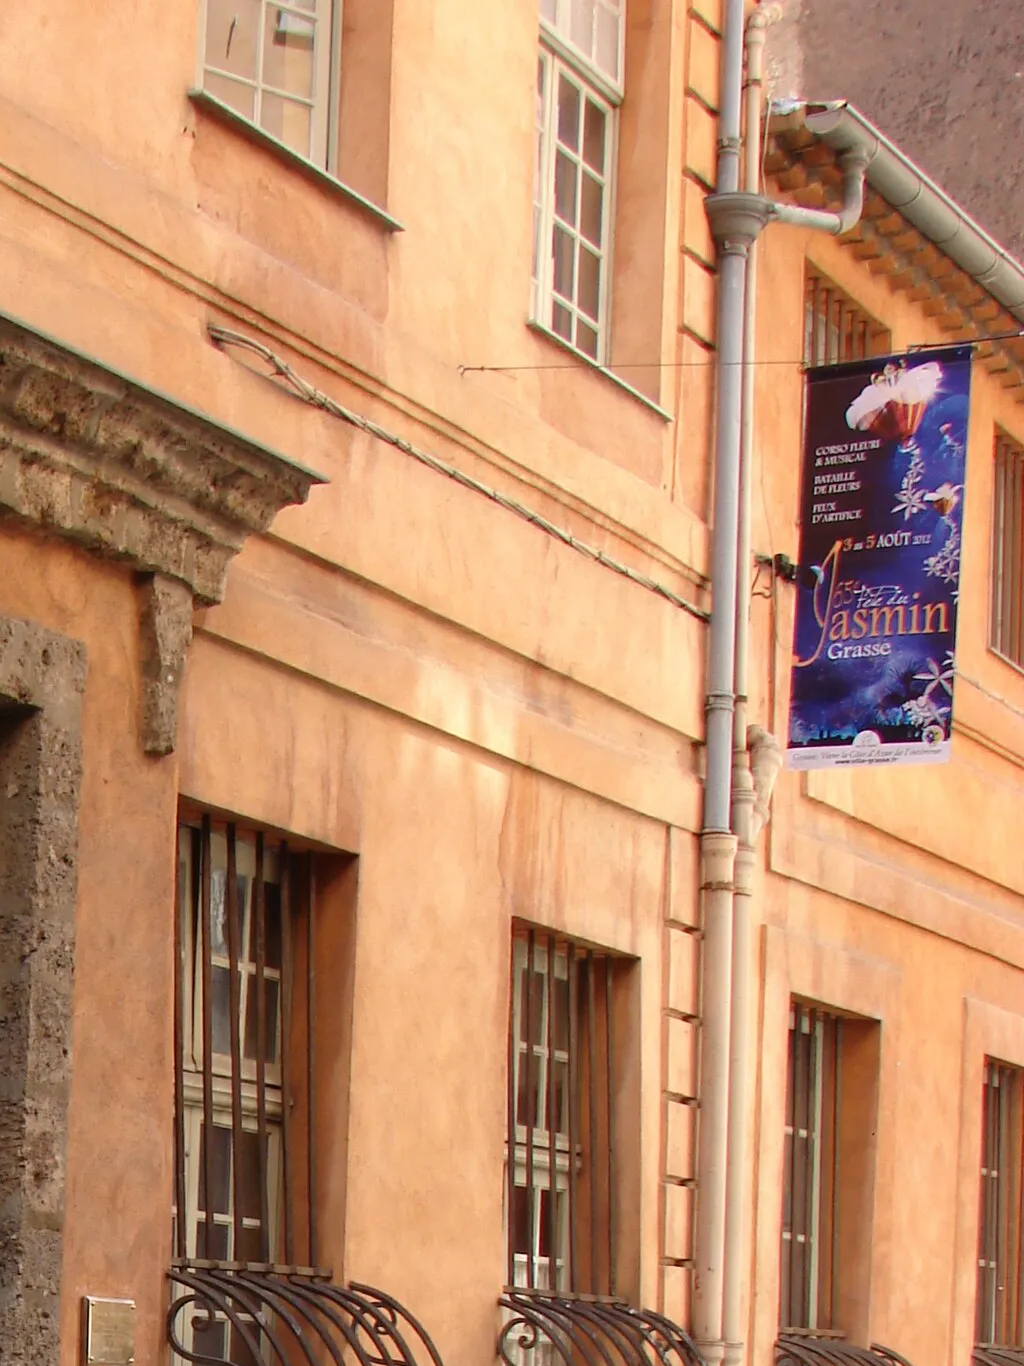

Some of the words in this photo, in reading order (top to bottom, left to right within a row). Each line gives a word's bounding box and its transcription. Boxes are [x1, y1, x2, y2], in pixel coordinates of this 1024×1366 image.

[815, 444, 849, 456] CORSO
[850, 439, 881, 452] FLEURI
[824, 452, 867, 466] MUSICAL
[814, 471, 856, 484] BATAILLE
[813, 485, 827, 495] DE
[828, 481, 861, 493] FLEURS
[812, 502, 836, 513] FEUX
[812, 509, 862, 524] D'ARTIFICE
[842, 538, 853, 552] 3
[865, 534, 876, 549] 5
[827, 641, 892, 660] Grasse
